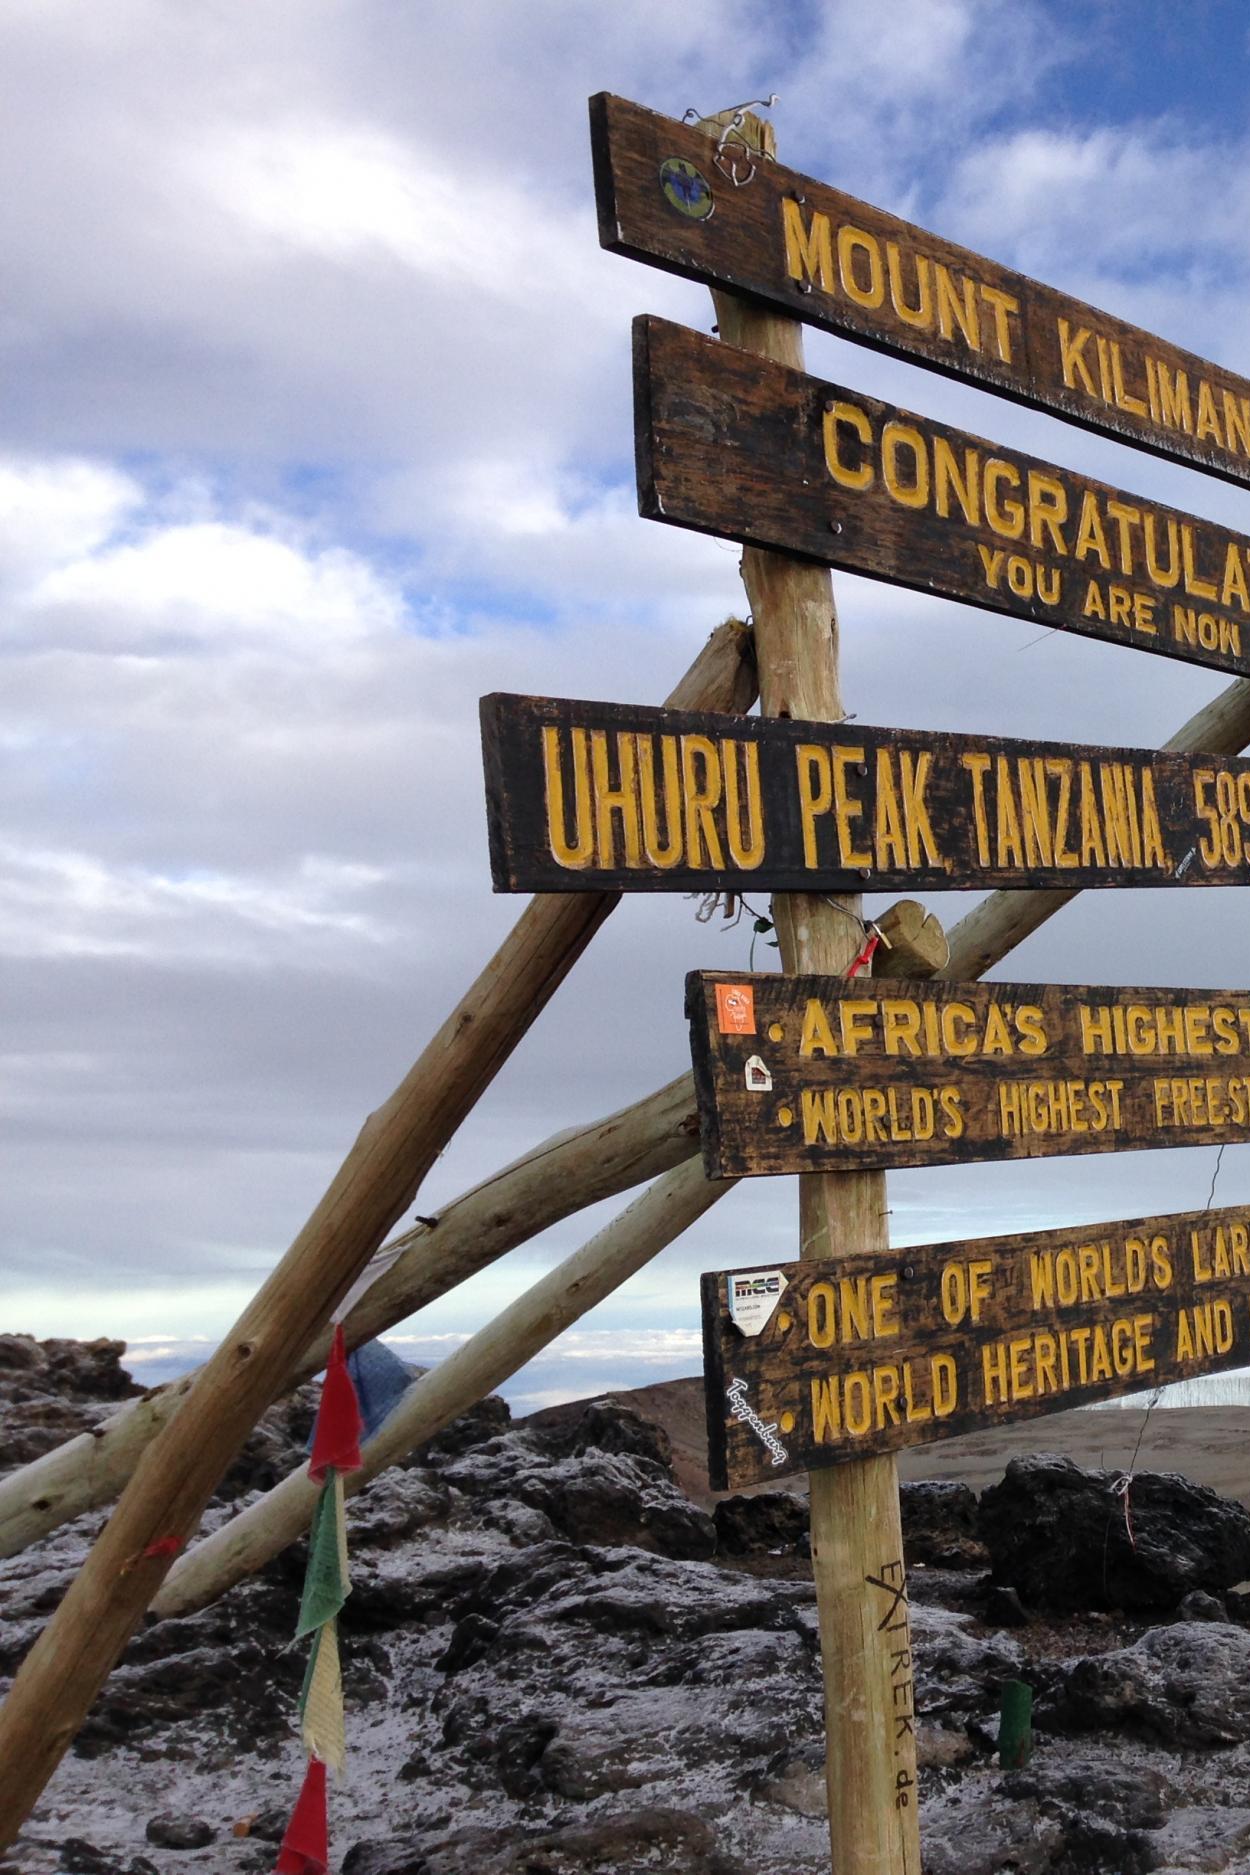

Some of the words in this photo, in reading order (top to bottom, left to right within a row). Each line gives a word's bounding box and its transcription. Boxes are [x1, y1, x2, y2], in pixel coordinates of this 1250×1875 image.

[782, 195, 1019, 364] MOUNT
[977, 543, 1062, 606] YOU
[1082, 580, 1158, 635] ARE
[1173, 604, 1242, 658] NOW
[541, 725, 766, 871] UHURU
[798, 998, 1048, 1057] AFRICA'S
[801, 1086, 964, 1146] WORLD'S
[999, 1078, 1125, 1136] HIGHEST
[807, 1273, 899, 1349] ONE
[940, 1258, 993, 1326] OF
[726, 1378, 788, 1465] Toggenburg
[810, 1353, 958, 1445] WORLD
[982, 1313, 1156, 1406] HERITAGE
[1176, 1299, 1234, 1363] AND
